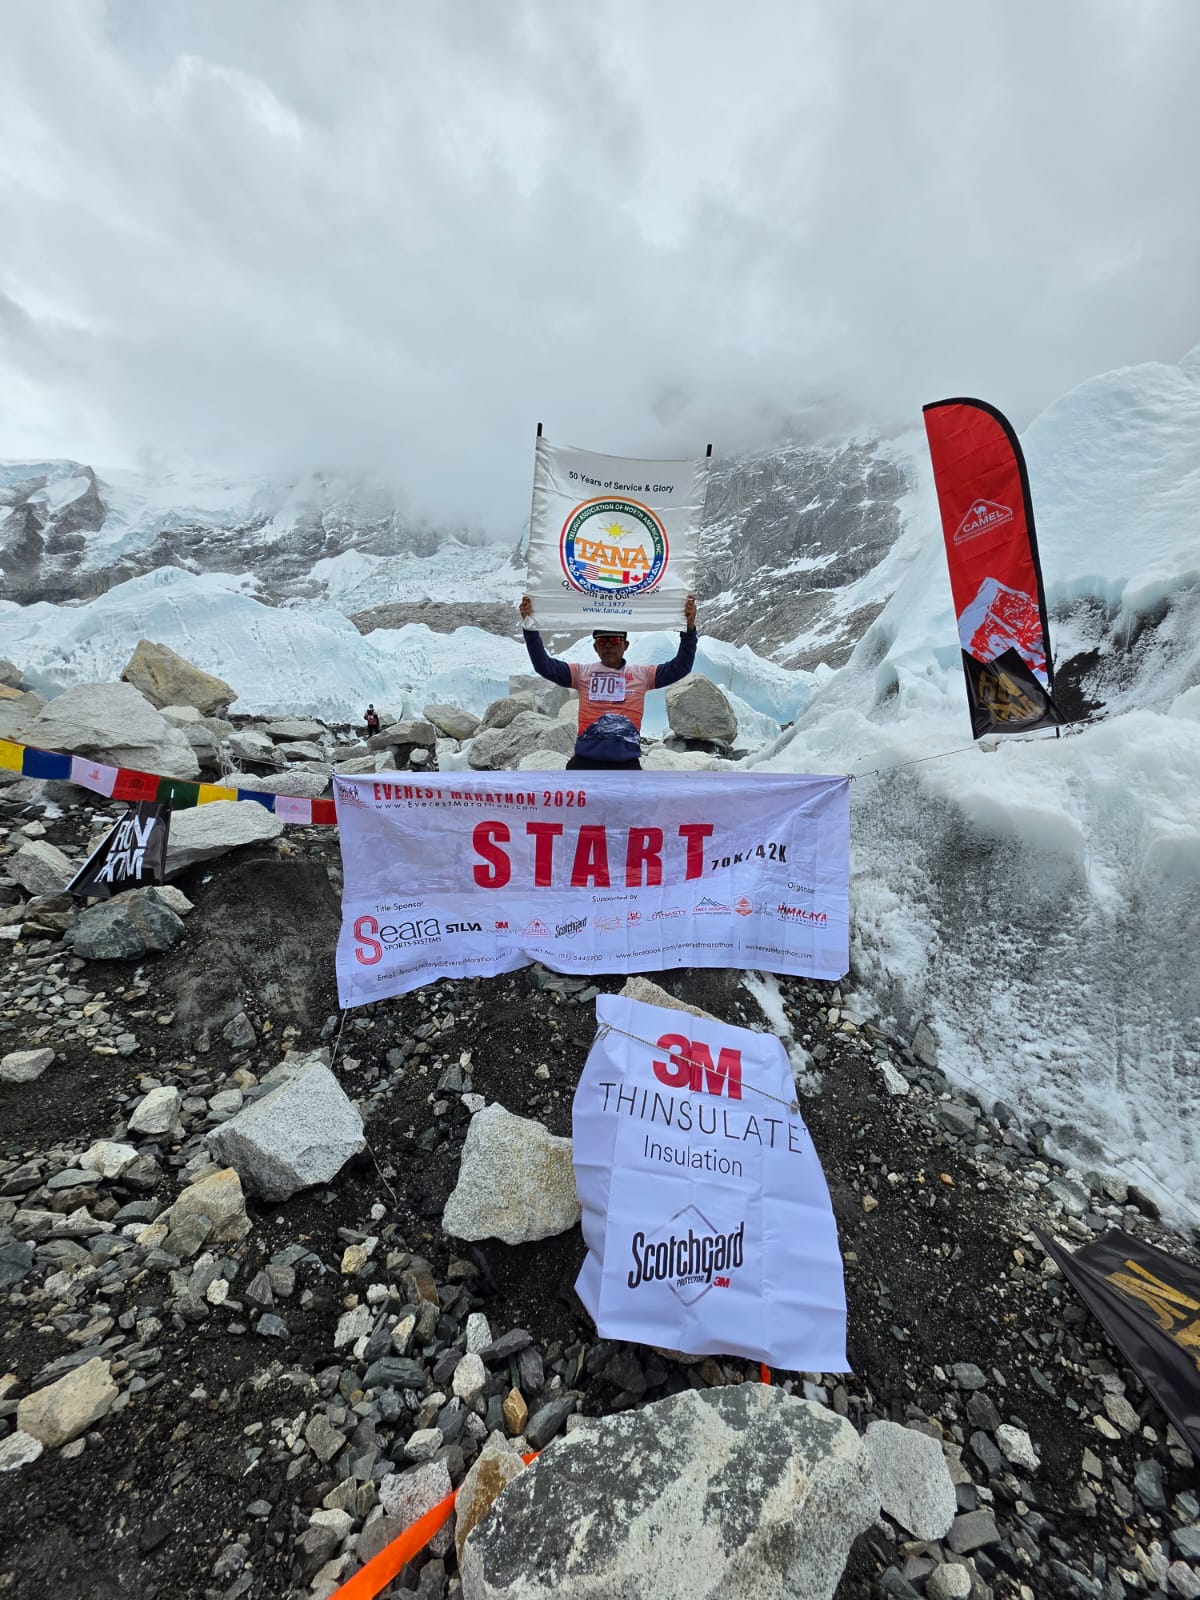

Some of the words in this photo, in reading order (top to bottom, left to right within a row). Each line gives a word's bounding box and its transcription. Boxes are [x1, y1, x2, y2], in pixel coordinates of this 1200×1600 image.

[569, 471, 578, 480] 50
[580, 474, 601, 486] Years
[614, 482, 642, 492] Service
[645, 484, 651, 492] &
[653, 484, 674, 493] Glory
[579, 503, 614, 520] ASSOCIATION
[624, 505, 643, 519] NORTH
[962, 510, 1004, 533] CAMEL
[575, 537, 650, 570] TANA
[591, 677, 616, 694] 870
[373, 782, 443, 801] EVEREST
[451, 789, 536, 806] MARATHON
[543, 790, 587, 808] 2026
[472, 820, 714, 888] START
[711, 842, 788, 871] 70K/42K
[393, 901, 424, 911] Sponsor
[777, 902, 828, 922] HIMALAYA
[445, 922, 482, 934] SILVA
[495, 921, 509, 929] 3M
[353, 915, 441, 966] Seara
[652, 1033, 743, 1100] 3M
[599, 1082, 803, 1155] THINSULATE
[644, 1135, 743, 1177] Insulation
[628, 1221, 744, 1289] Scotchgard
[713, 1276, 731, 1288] 3M
